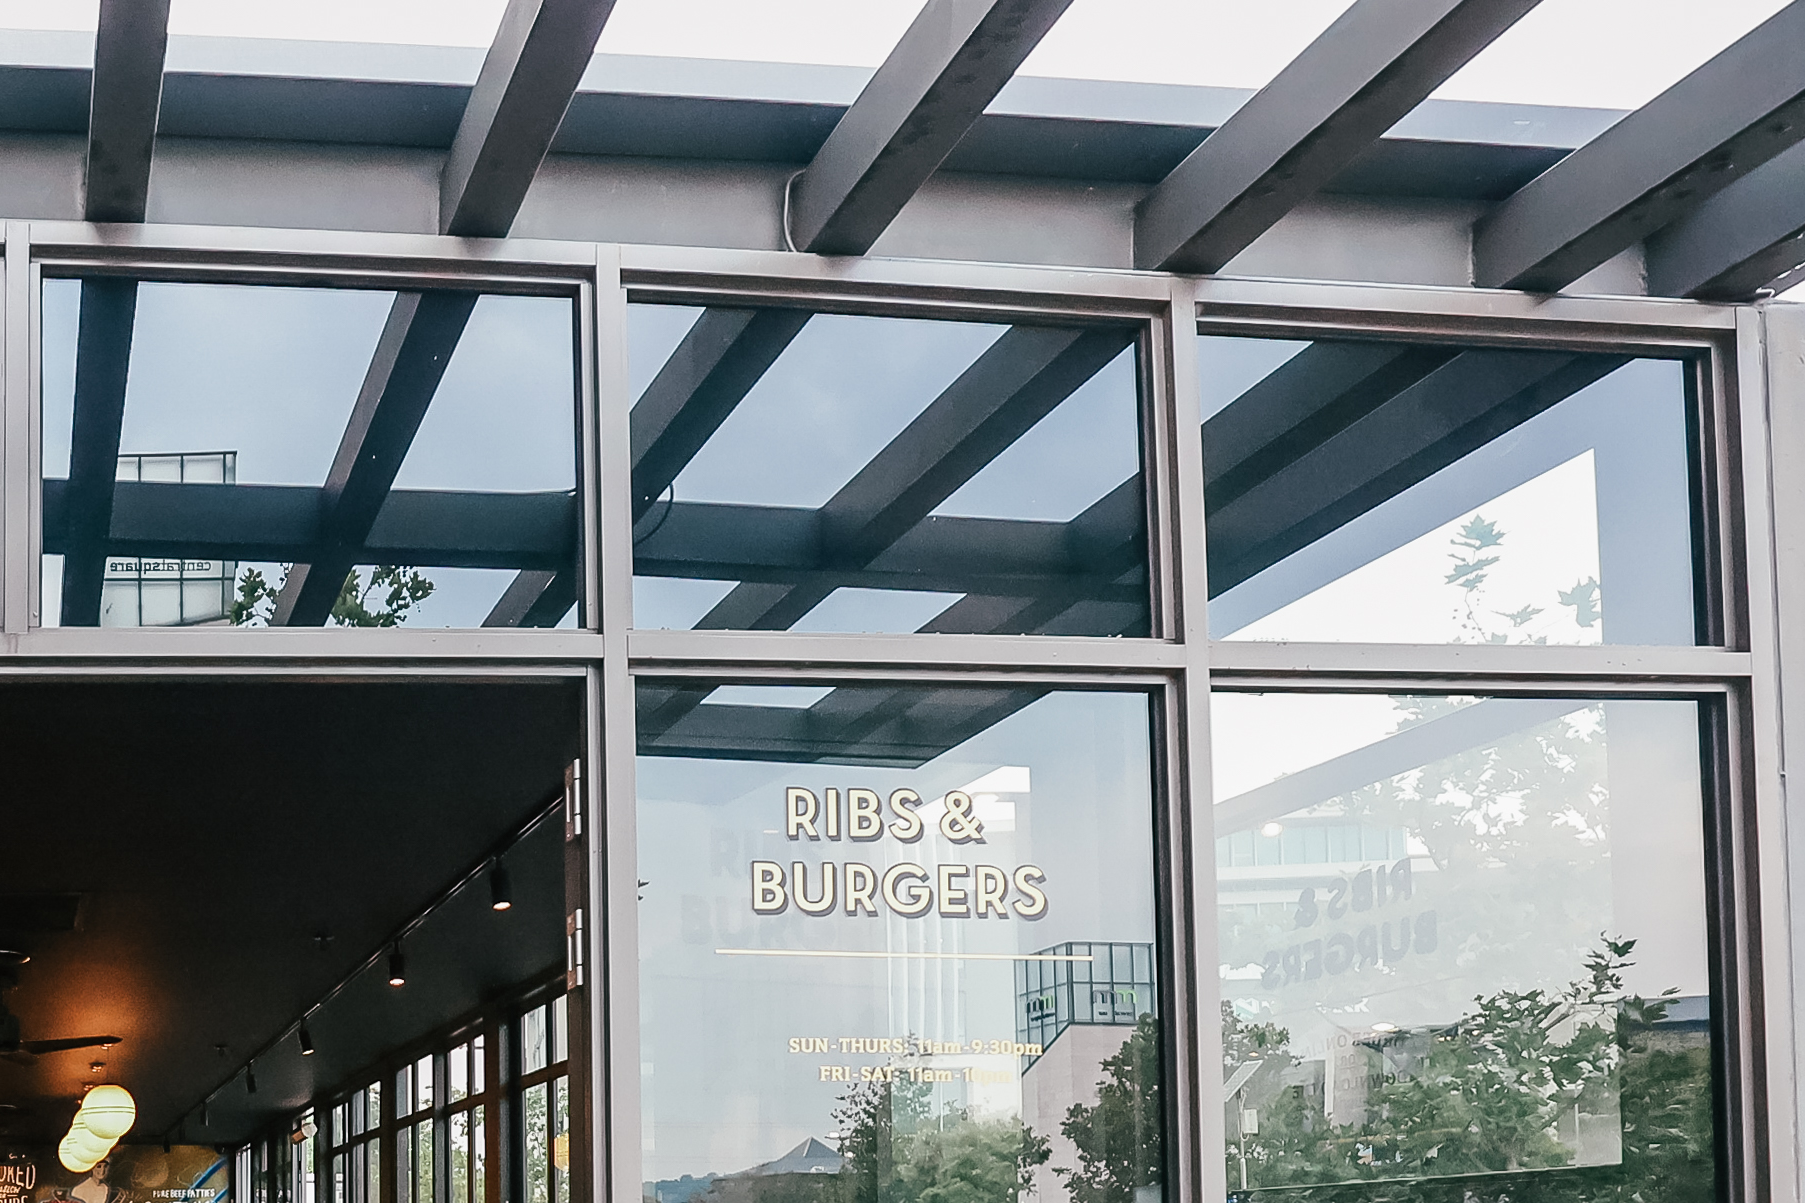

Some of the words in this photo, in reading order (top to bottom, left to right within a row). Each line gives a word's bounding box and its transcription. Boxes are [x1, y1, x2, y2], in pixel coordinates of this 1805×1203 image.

[785, 786, 924, 844] RIBS
[938, 789, 987, 845] &
[750, 860, 1049, 921] BURGERS
[152, 1189, 170, 1198] PURE
[170, 1189, 186, 1198] BEEF
[187, 1188, 216, 1198] PATTIES
